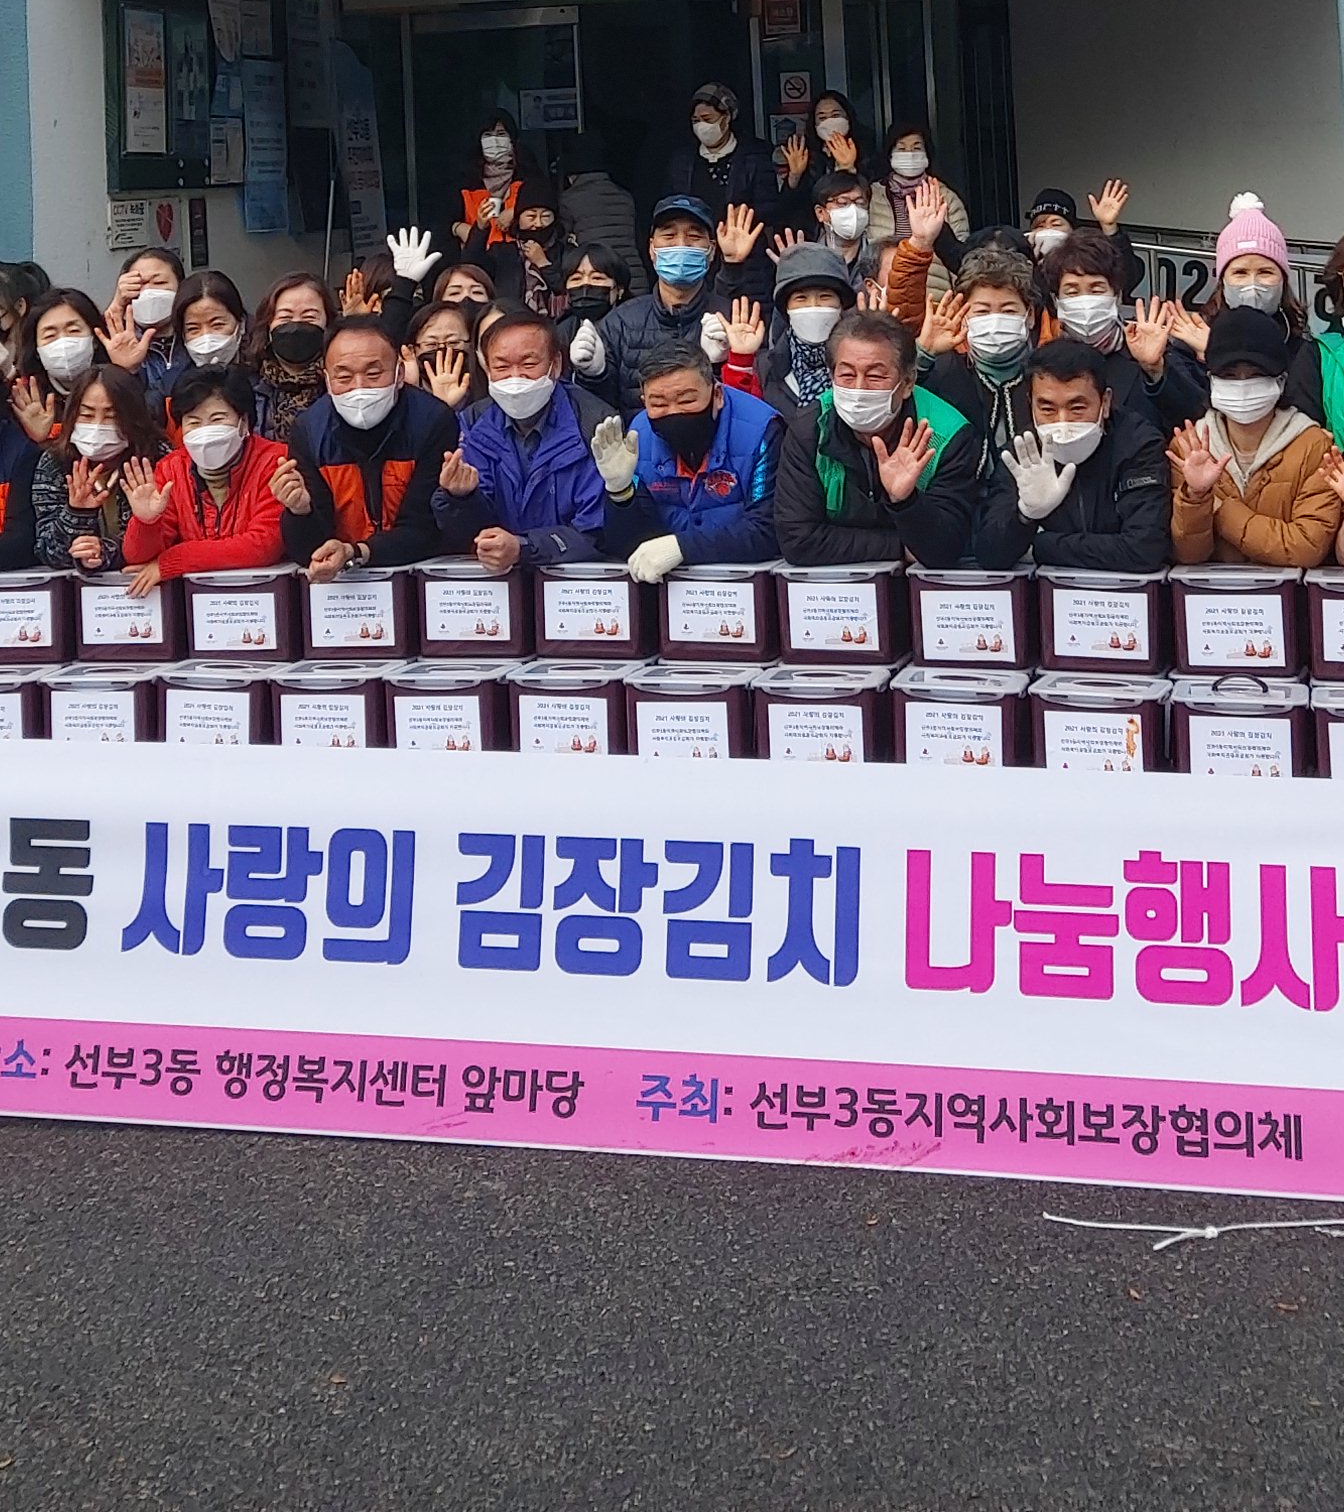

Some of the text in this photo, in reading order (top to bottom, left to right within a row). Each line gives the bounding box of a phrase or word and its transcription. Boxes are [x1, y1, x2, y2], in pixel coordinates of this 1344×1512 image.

[120, 821, 416, 965] 사랑의
[456, 832, 862, 988] 김장김치
[64, 1044, 202, 1095] 선부3동
[215, 1050, 448, 1106] 행정복지센터
[461, 1065, 586, 1120] 앞마당
[636, 1072, 733, 1123] 주최:
[749, 1079, 1306, 1162] 선부3동지역사회보장협의체
